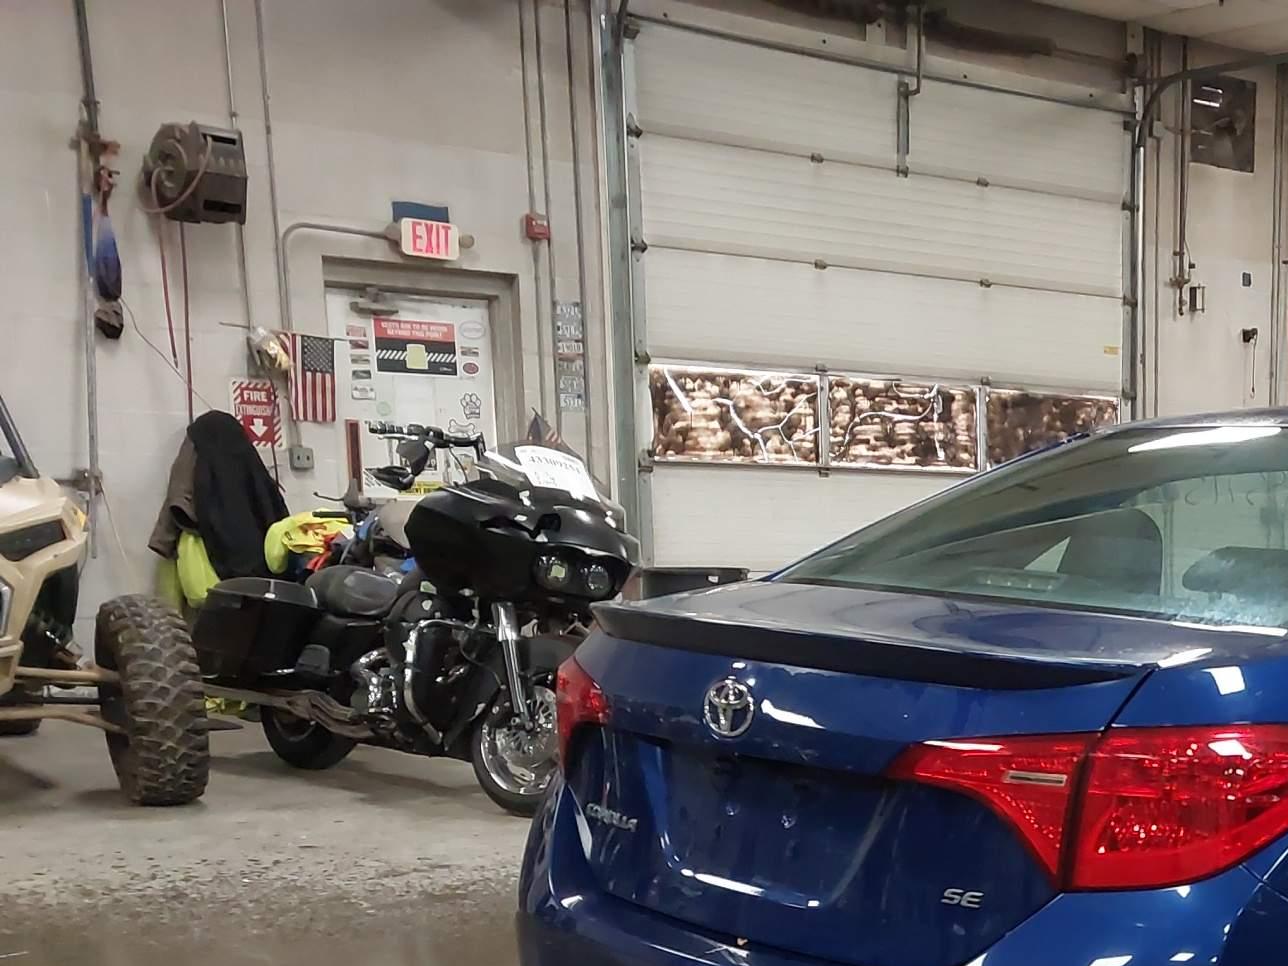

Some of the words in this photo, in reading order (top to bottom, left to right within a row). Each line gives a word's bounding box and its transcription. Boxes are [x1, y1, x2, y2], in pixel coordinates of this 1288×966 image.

[412, 221, 451, 256] EXIT
[243, 390, 268, 402] FIRE
[941, 888, 984, 908] SE
